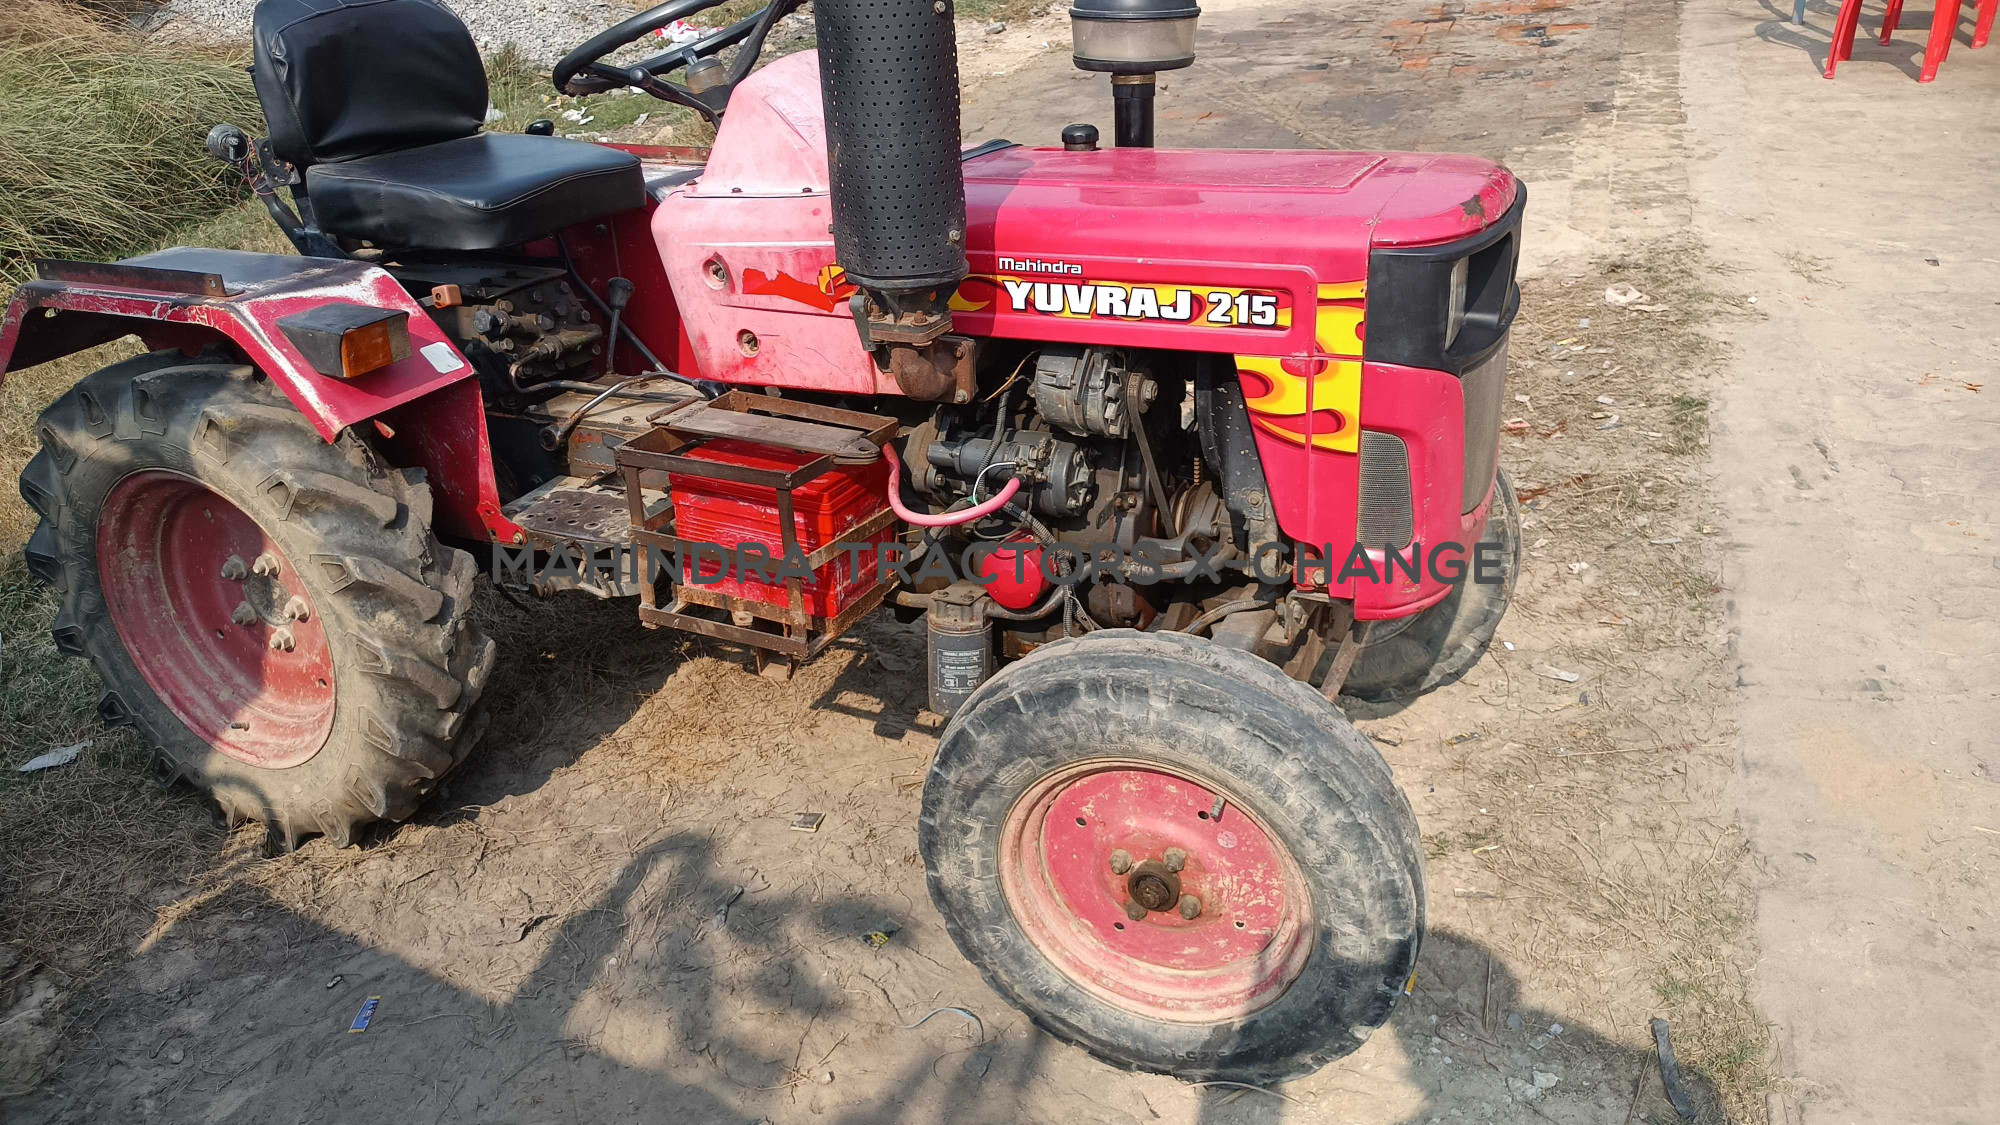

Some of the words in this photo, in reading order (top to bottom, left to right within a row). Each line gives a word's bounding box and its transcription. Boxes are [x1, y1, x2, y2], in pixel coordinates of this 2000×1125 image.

[998, 257, 1082, 275] Mahindra
[1003, 279, 1192, 321] YUVRAJ
[1206, 291, 1278, 326] 215
